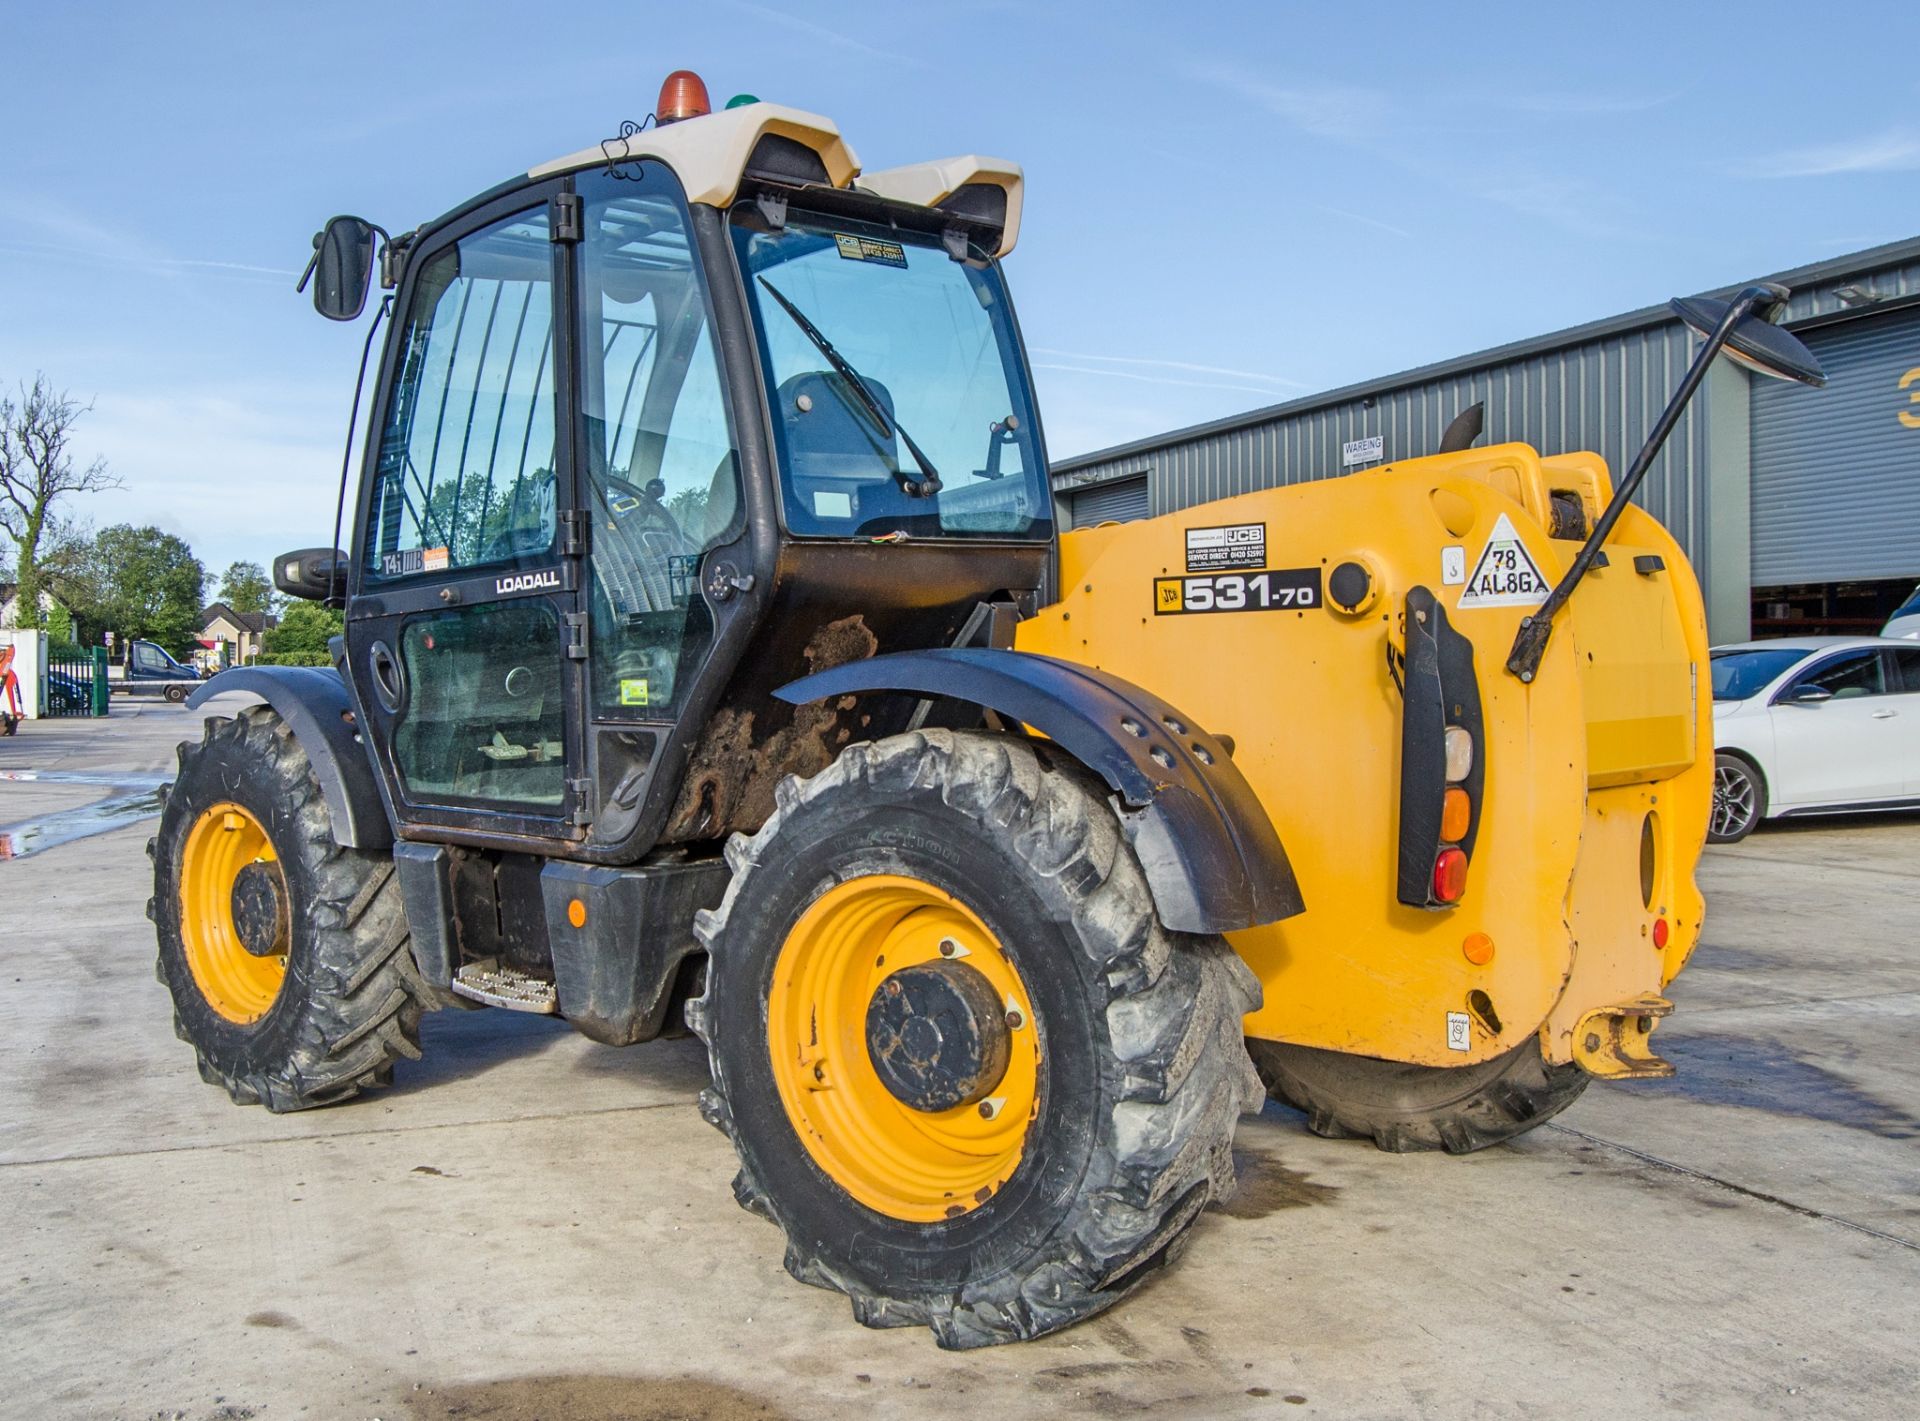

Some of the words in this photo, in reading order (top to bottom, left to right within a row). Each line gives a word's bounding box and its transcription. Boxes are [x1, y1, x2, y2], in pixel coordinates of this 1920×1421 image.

[1345, 437, 1382, 454] WAREING
[1228, 529, 1261, 543] JCB
[383, 553, 402, 575] T4i
[1209, 552, 1228, 560] DIRECT
[1230, 551, 1246, 559] 01420
[1247, 550, 1264, 558] 525917
[1493, 549, 1517, 572] 78
[496, 571, 560, 595] LOADALL
[1184, 574, 1314, 611] 531-70
[1480, 571, 1532, 596] AL8G
[1163, 588, 1178, 604] JCB
